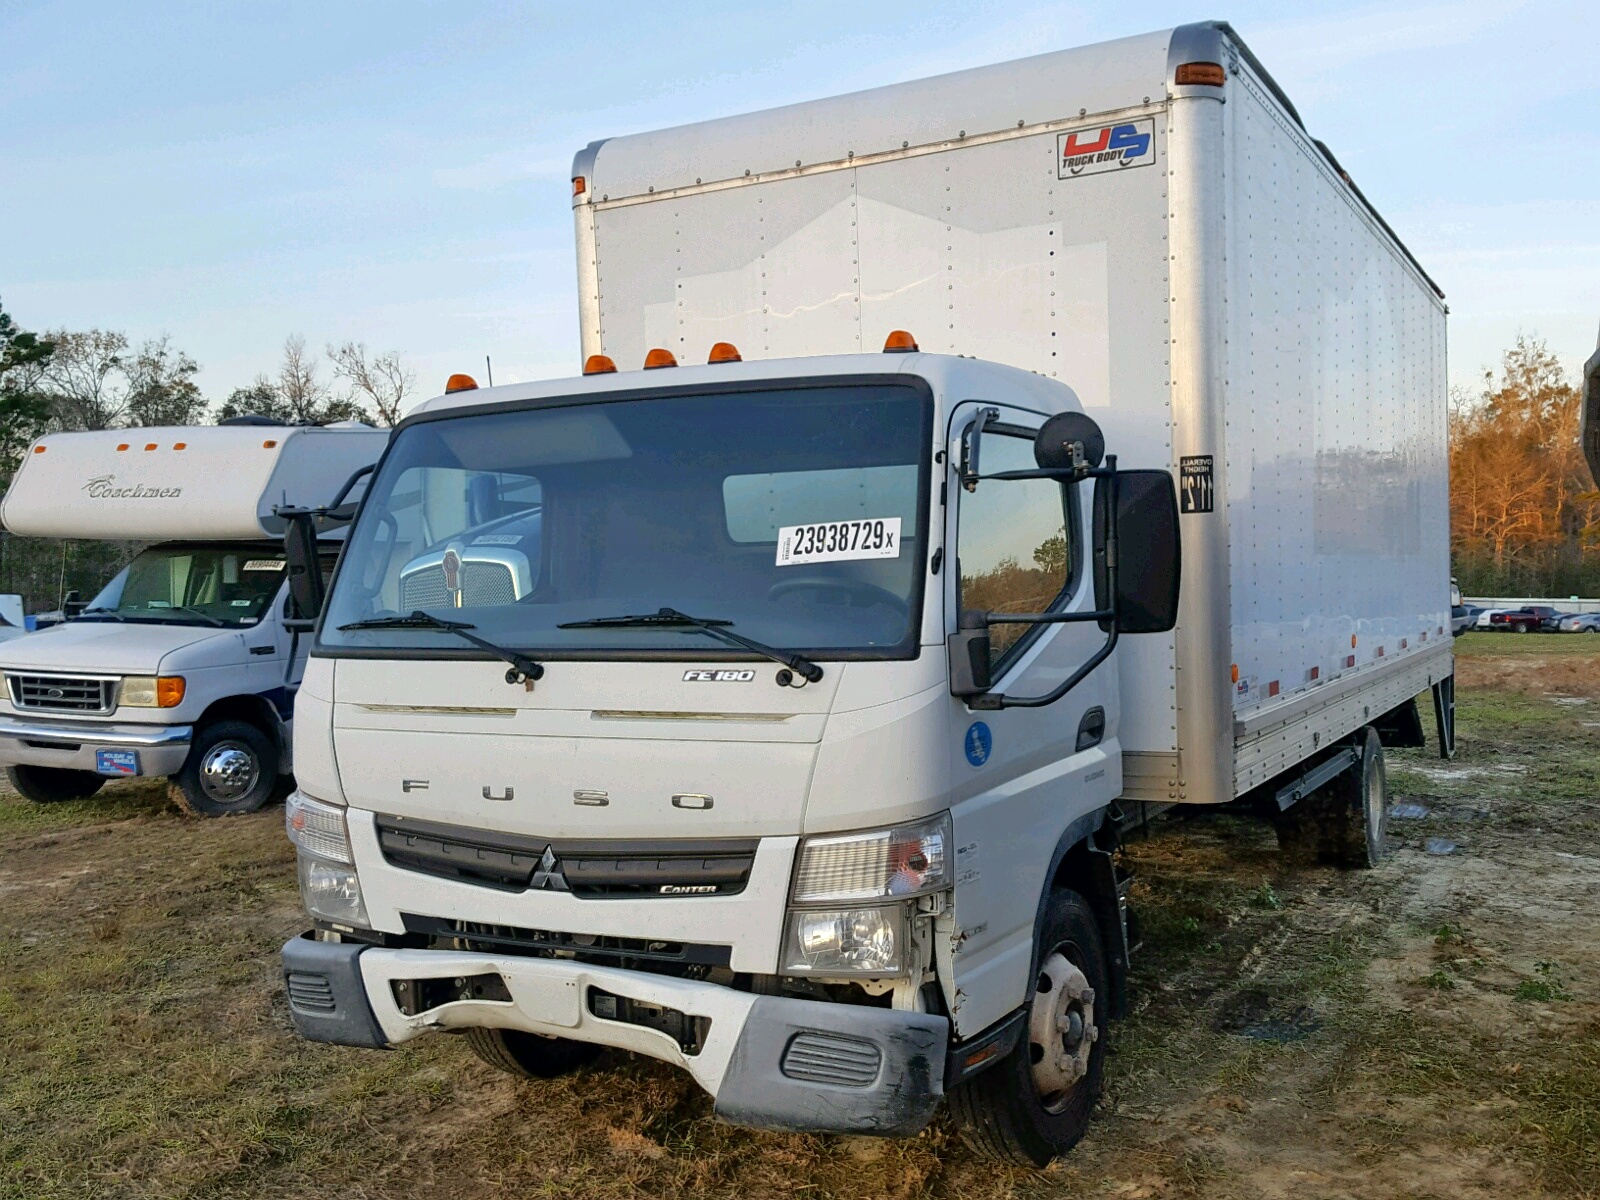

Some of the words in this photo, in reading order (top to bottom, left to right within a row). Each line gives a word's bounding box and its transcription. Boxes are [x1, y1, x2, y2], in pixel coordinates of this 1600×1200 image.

[1063, 124, 1151, 158] US
[1062, 153, 1095, 168] TRUCK
[1095, 149, 1125, 164] BODY
[89, 482, 182, 498] Coachmen
[793, 520, 884, 555] 23938729
[402, 779, 714, 810] FUSO
